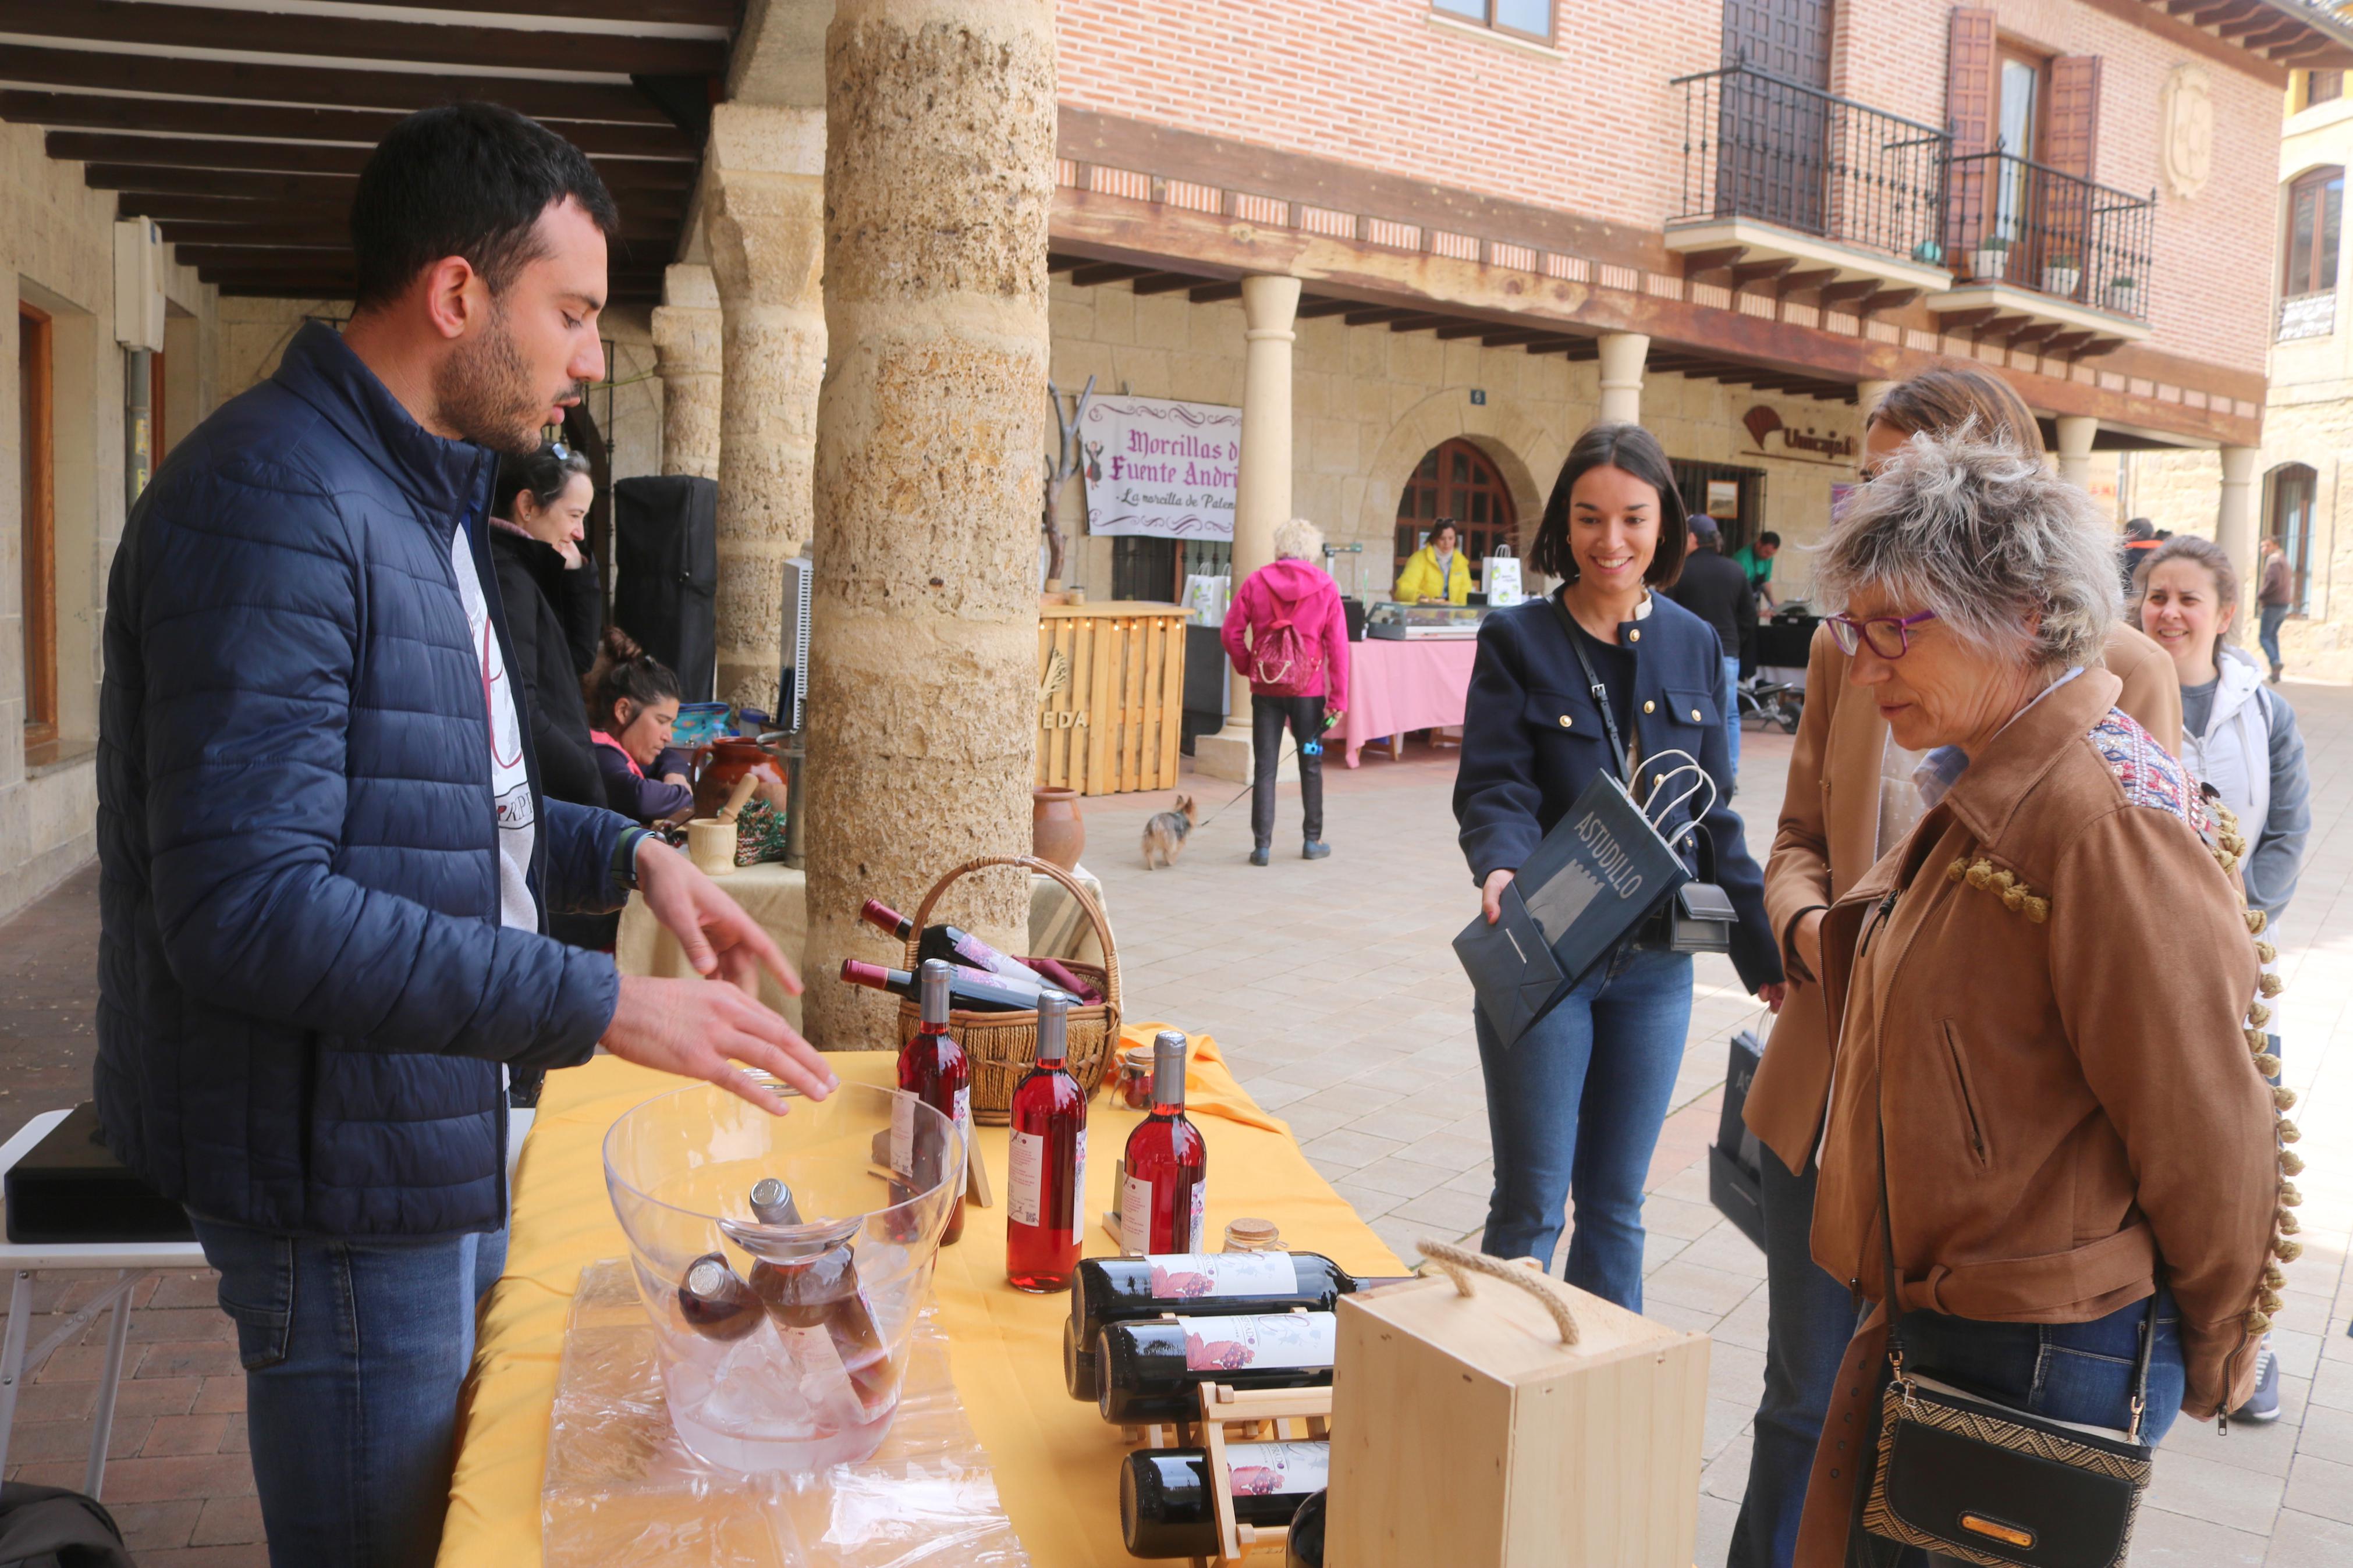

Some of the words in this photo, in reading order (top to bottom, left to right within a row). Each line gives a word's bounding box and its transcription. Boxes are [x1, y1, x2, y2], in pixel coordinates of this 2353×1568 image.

[1127, 429, 1222, 458] Morcillas
[1229, 440, 1238, 461] d
[1108, 455, 1177, 483] Fuente
[1183, 461, 1238, 489] Andri
[1142, 492, 1183, 506] morcilla
[1185, 495, 1198, 507] de
[1201, 494, 1236, 510] Palen
[1041, 710, 1088, 730] EDA
[1574, 811, 1643, 899] ASTUDILLO
